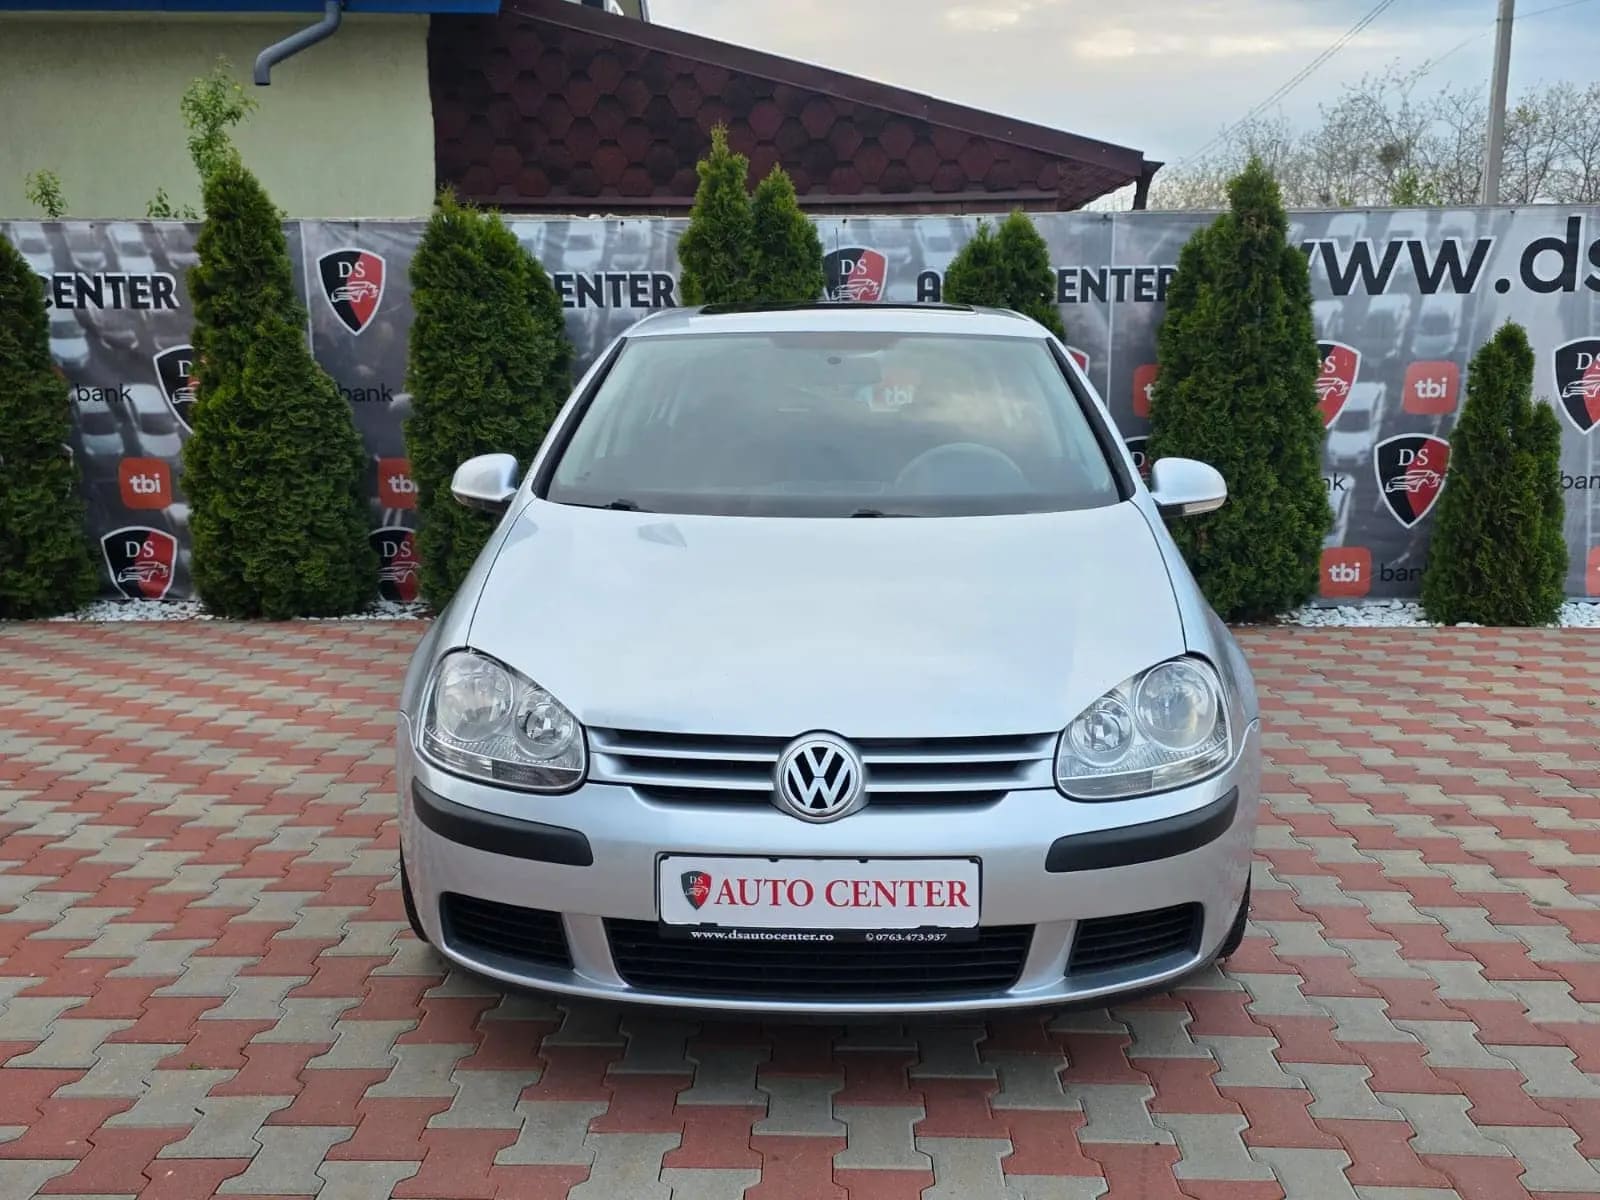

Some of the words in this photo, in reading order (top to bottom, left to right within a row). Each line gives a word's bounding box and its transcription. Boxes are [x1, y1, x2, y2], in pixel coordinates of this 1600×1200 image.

[1301, 216, 1600, 296] ww.d
[338, 262, 366, 278] DS
[840, 259, 868, 276] DS
[553, 273, 677, 308] ENTER
[1317, 355, 1336, 374] S
[76, 384, 133, 402] bank
[1414, 377, 1448, 398] tbi
[1398, 448, 1429, 466] DS
[129, 473, 161, 494] tbi
[1560, 470, 1600, 489] ban
[126, 541, 154, 558] DS
[382, 541, 412, 557] DS
[1328, 562, 1361, 582] tbi
[1380, 563, 1428, 582] ban
[714, 878, 814, 906] AUTO
[824, 879, 970, 908] CENTER
[690, 929, 834, 941] www.dsautocenter.ro
